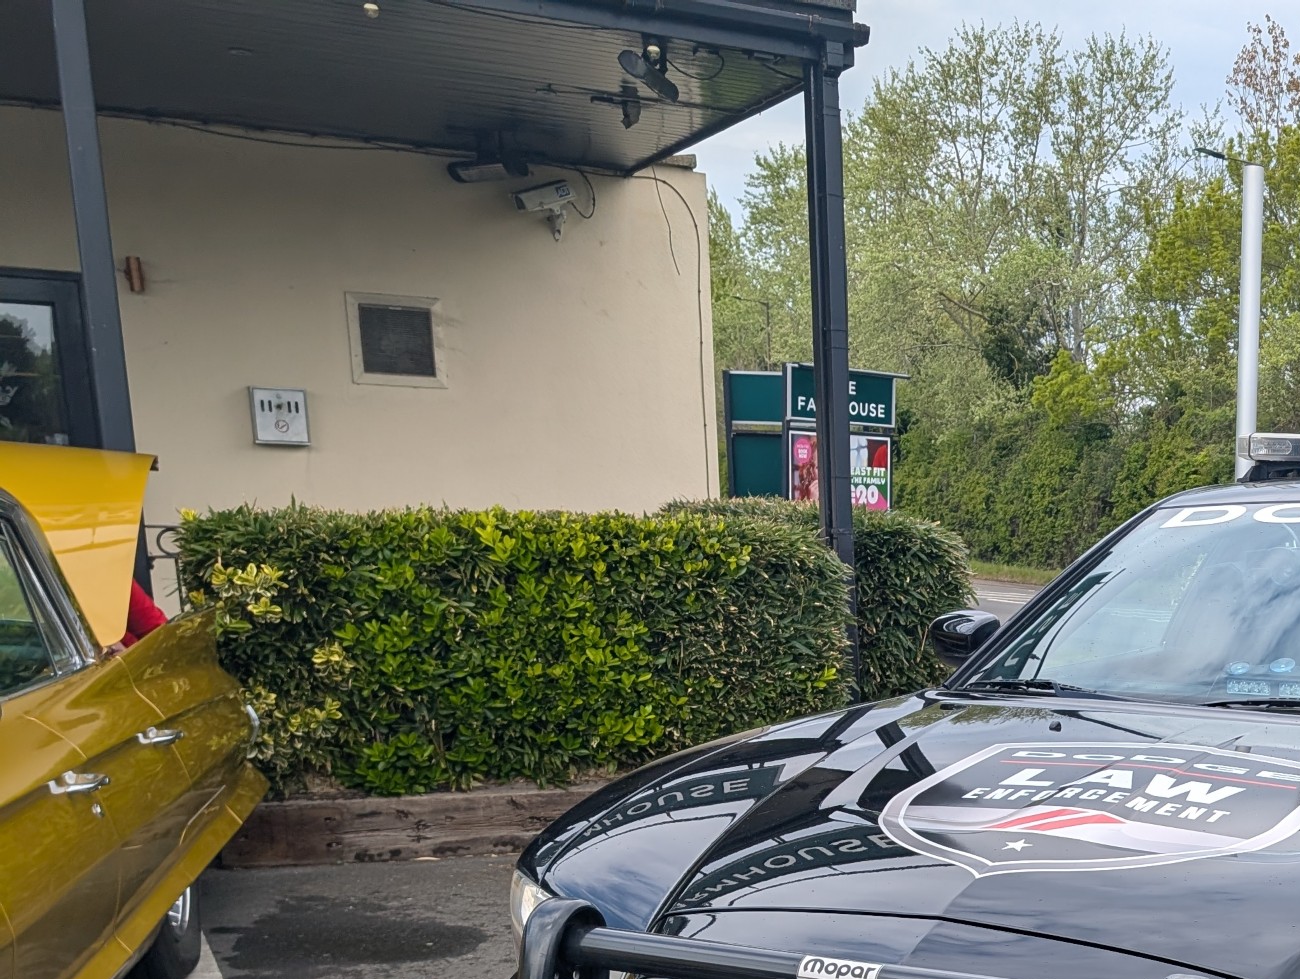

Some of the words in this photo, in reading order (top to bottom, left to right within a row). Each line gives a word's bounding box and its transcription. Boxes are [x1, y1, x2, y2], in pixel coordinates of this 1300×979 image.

[797, 395, 886, 418] FAOUSE
[851, 466, 871, 476] EAST
[873, 467, 885, 477] FIT
[863, 477, 885, 485] FAMILY
[998, 768, 1247, 804] LAW
[961, 787, 1231, 823] ENFORCEMENT
